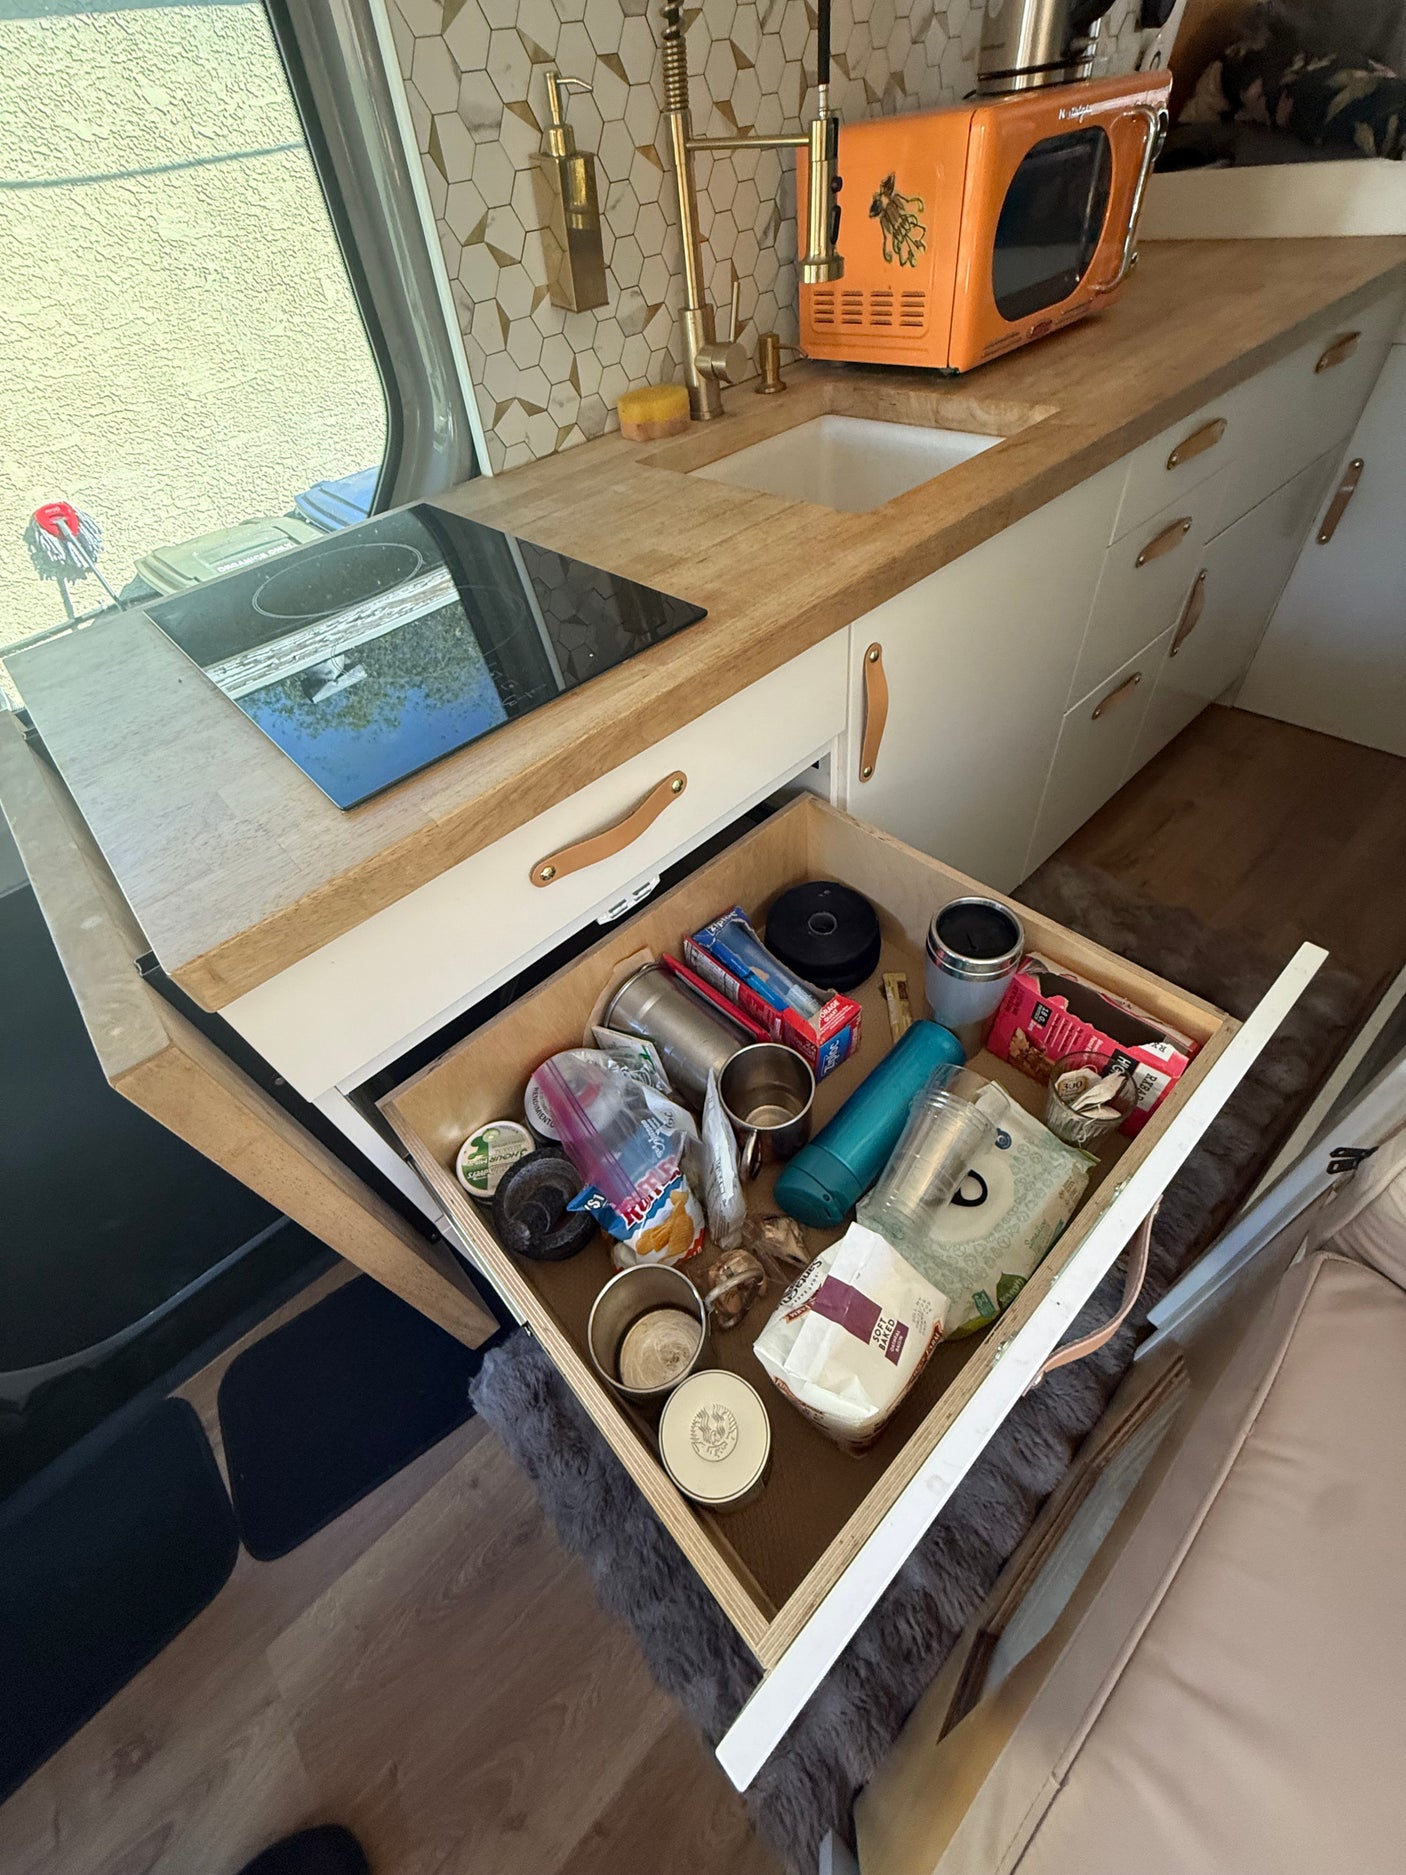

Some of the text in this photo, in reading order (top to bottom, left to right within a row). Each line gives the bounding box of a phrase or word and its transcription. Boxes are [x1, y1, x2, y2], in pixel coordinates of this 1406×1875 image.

[819, 999, 840, 1019] ORAGE
[1109, 1055, 1132, 1077] HIG
[873, 1317, 887, 1343] SOFT
[878, 1319, 895, 1350] BAKED
